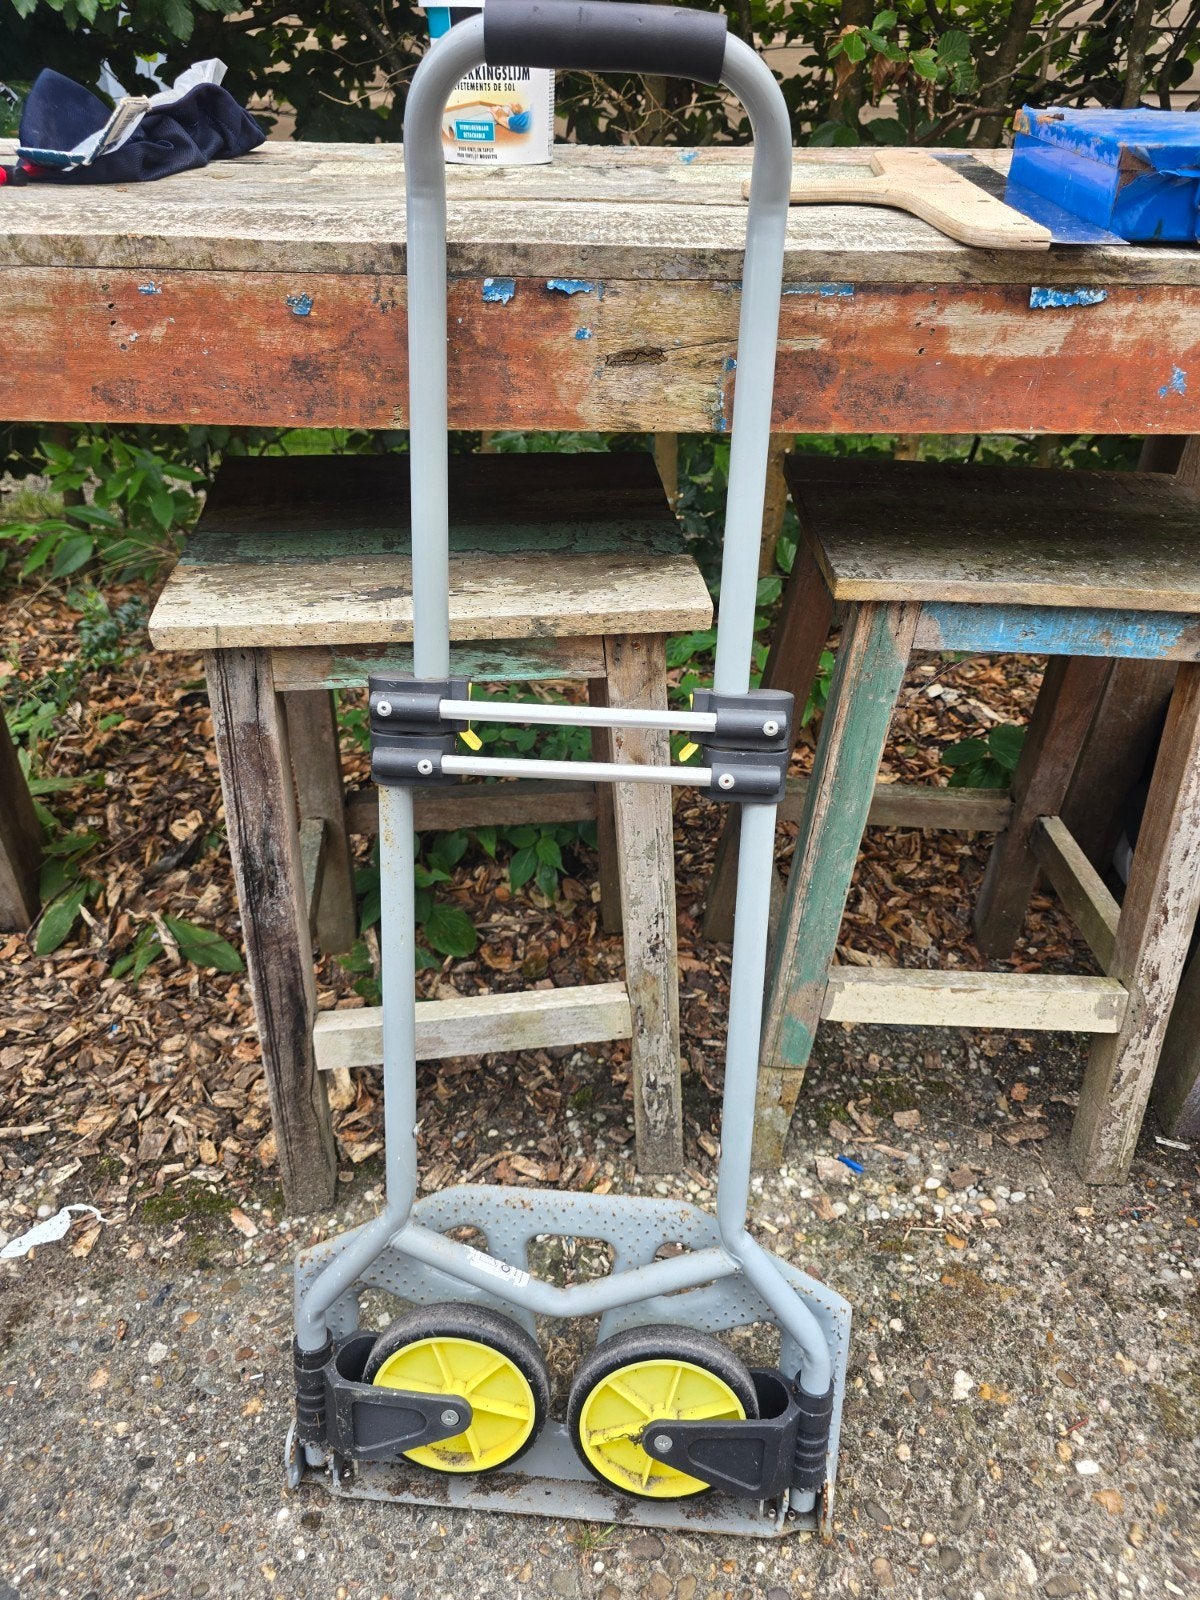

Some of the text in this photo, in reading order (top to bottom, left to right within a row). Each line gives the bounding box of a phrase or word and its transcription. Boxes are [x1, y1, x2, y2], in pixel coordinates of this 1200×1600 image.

[463, 66, 530, 81] KKINGSLIJM
[493, 83, 502, 91] DE
[504, 83, 516, 92] SOL
